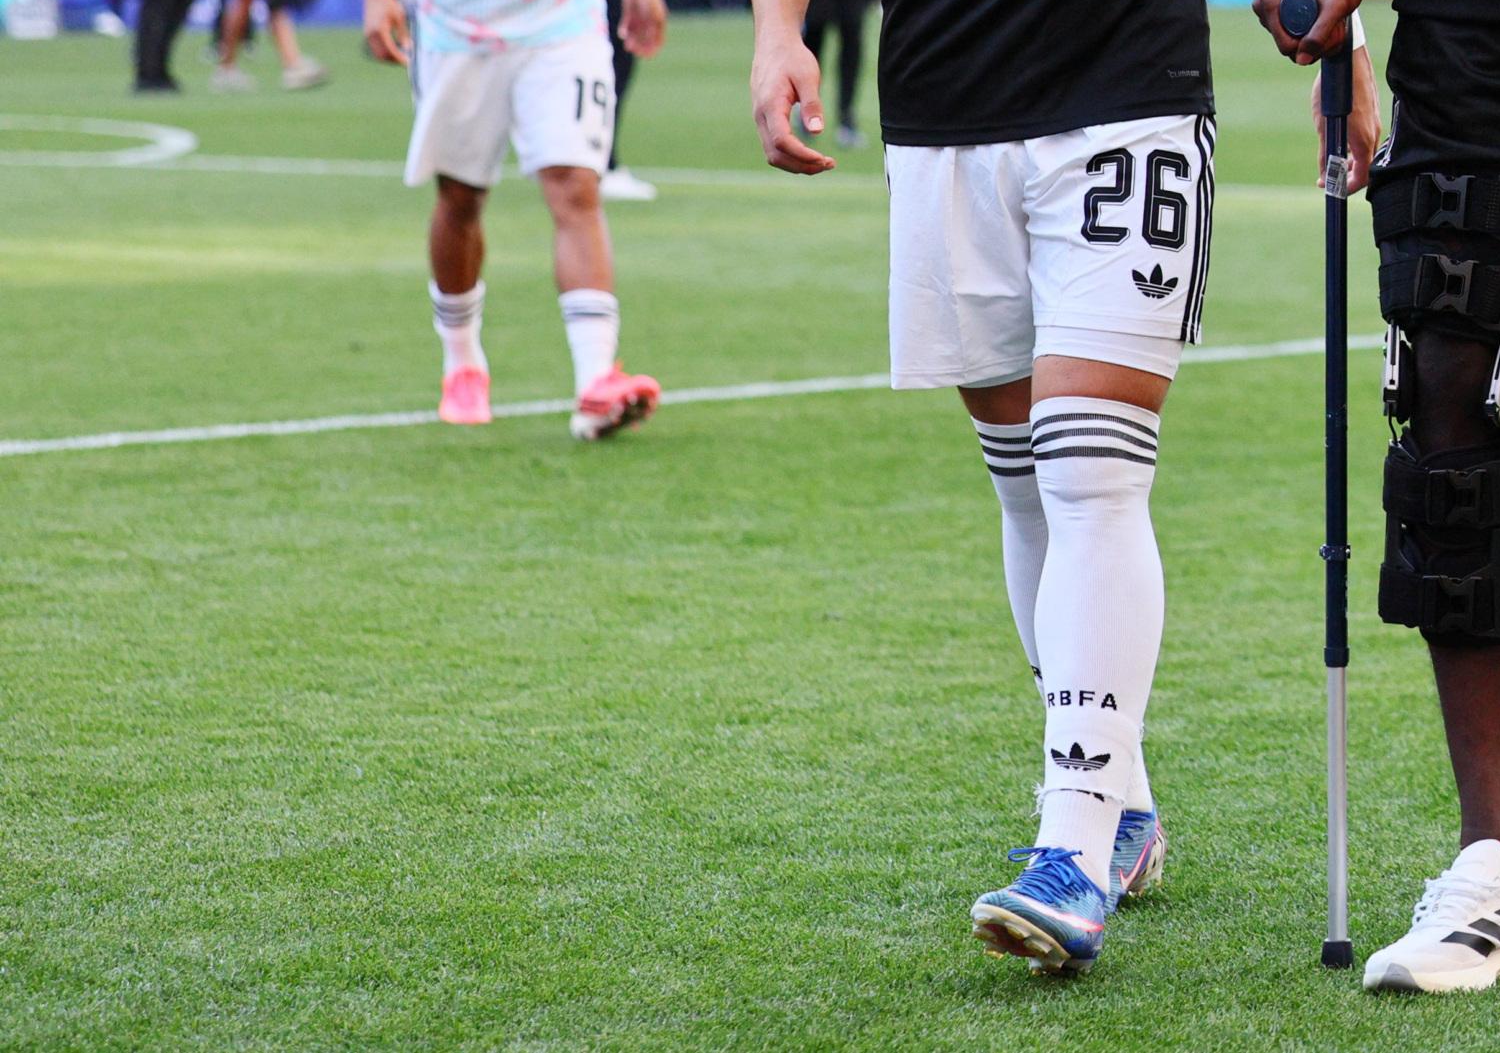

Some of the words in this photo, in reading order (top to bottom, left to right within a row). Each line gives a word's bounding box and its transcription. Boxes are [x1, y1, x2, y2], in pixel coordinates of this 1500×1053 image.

[575, 77, 606, 126] 19
[1081, 147, 1192, 253] 26
[1047, 689, 1118, 711] RBFA
